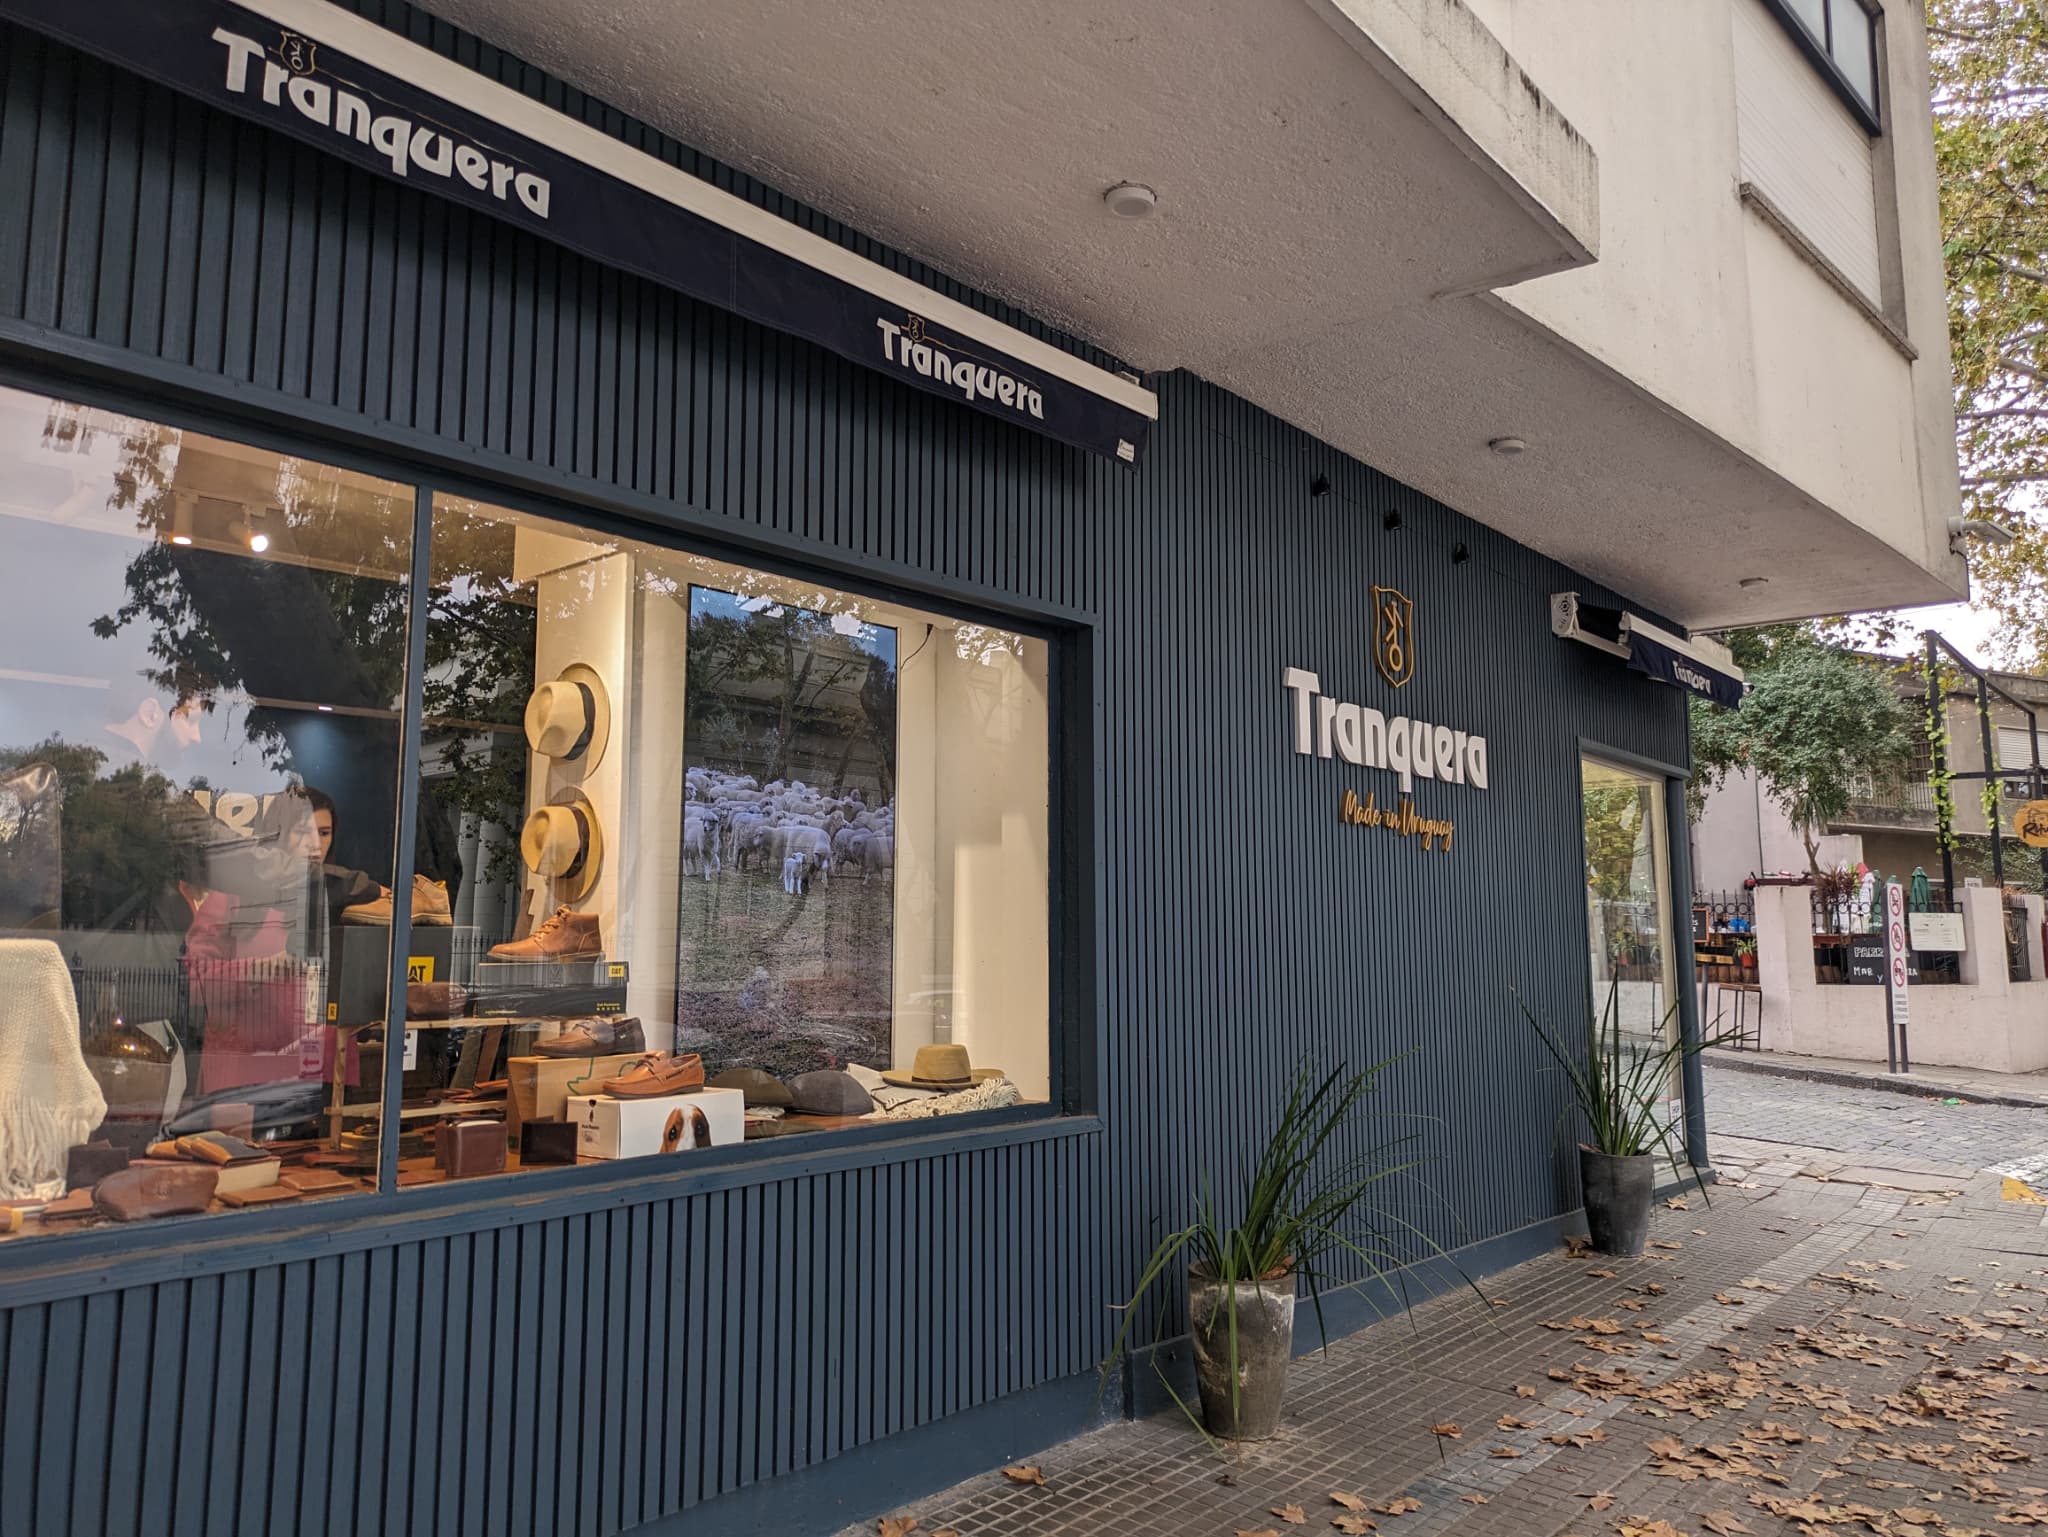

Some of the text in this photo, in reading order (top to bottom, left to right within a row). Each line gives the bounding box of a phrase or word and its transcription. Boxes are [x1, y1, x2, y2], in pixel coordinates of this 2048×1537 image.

[212, 27, 550, 220] Tranquera
[876, 317, 1045, 420] Tranquera
[1672, 660, 1711, 695] Tranea
[1283, 666, 1489, 793] Tranquera
[1342, 789, 1455, 853] Made in Uruguay
[408, 965, 426, 983] AT
